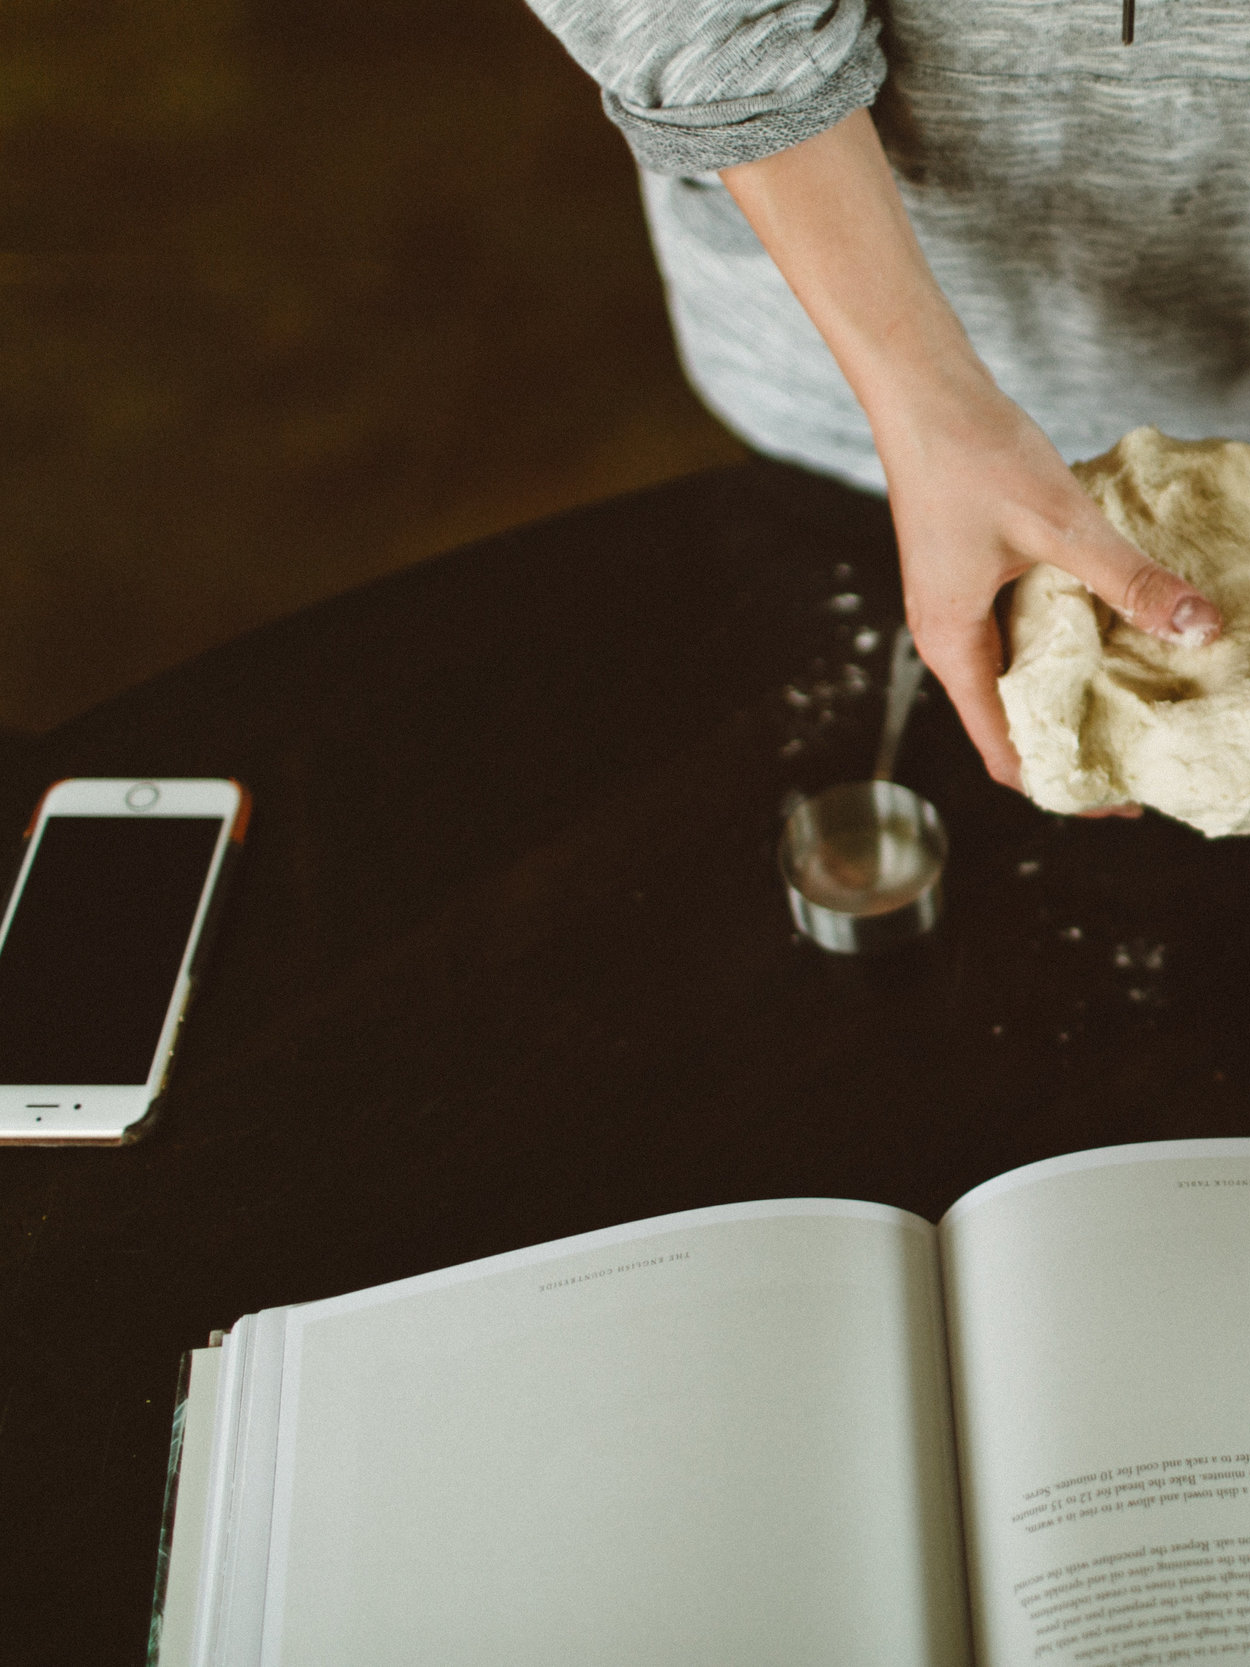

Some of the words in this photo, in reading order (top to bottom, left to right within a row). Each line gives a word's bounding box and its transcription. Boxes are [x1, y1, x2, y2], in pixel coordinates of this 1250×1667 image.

[669, 1252, 690, 1261] THE
[617, 1257, 664, 1272] ENGLISH
[539, 1268, 613, 1292] COUNTRYSIDE
[1185, 1457, 1208, 1468] rack
[1221, 1455, 1231, 1463] to
[1136, 1462, 1158, 1475] cool
[1162, 1460, 1182, 1472] and
[1100, 1470, 1113, 1481] 10
[1117, 1467, 1132, 1478] for
[1199, 1470, 1245, 1482] minutes.
[1148, 1478, 1166, 1489] the
[1169, 1474, 1196, 1487] Bake
[1096, 1488, 1111, 1499] for
[1115, 1481, 1145, 1496] bread
[1216, 1488, 1239, 1499] dish
[1066, 1495, 1076, 1504] to
[1080, 1491, 1092, 1503] 12
[1160, 1493, 1180, 1505] and
[1184, 1489, 1212, 1502] towel
[1051, 1499, 1062, 1512] 15
[1101, 1503, 1112, 1513] to
[1115, 1502, 1123, 1513] it
[1128, 1496, 1156, 1509] allow
[1066, 1513, 1076, 1522] in
[1079, 1507, 1098, 1518] rise
[1150, 1546, 1168, 1557] the
[1171, 1539, 1209, 1552] Repeat
[1092, 1546, 1146, 1566] procedure
[1218, 1556, 1235, 1567] the
[1066, 1562, 1089, 1574] with
[1128, 1565, 1153, 1576] olive
[1157, 1558, 1214, 1571] remaining
[1047, 1567, 1062, 1579] the
[1111, 1570, 1124, 1582] oil
